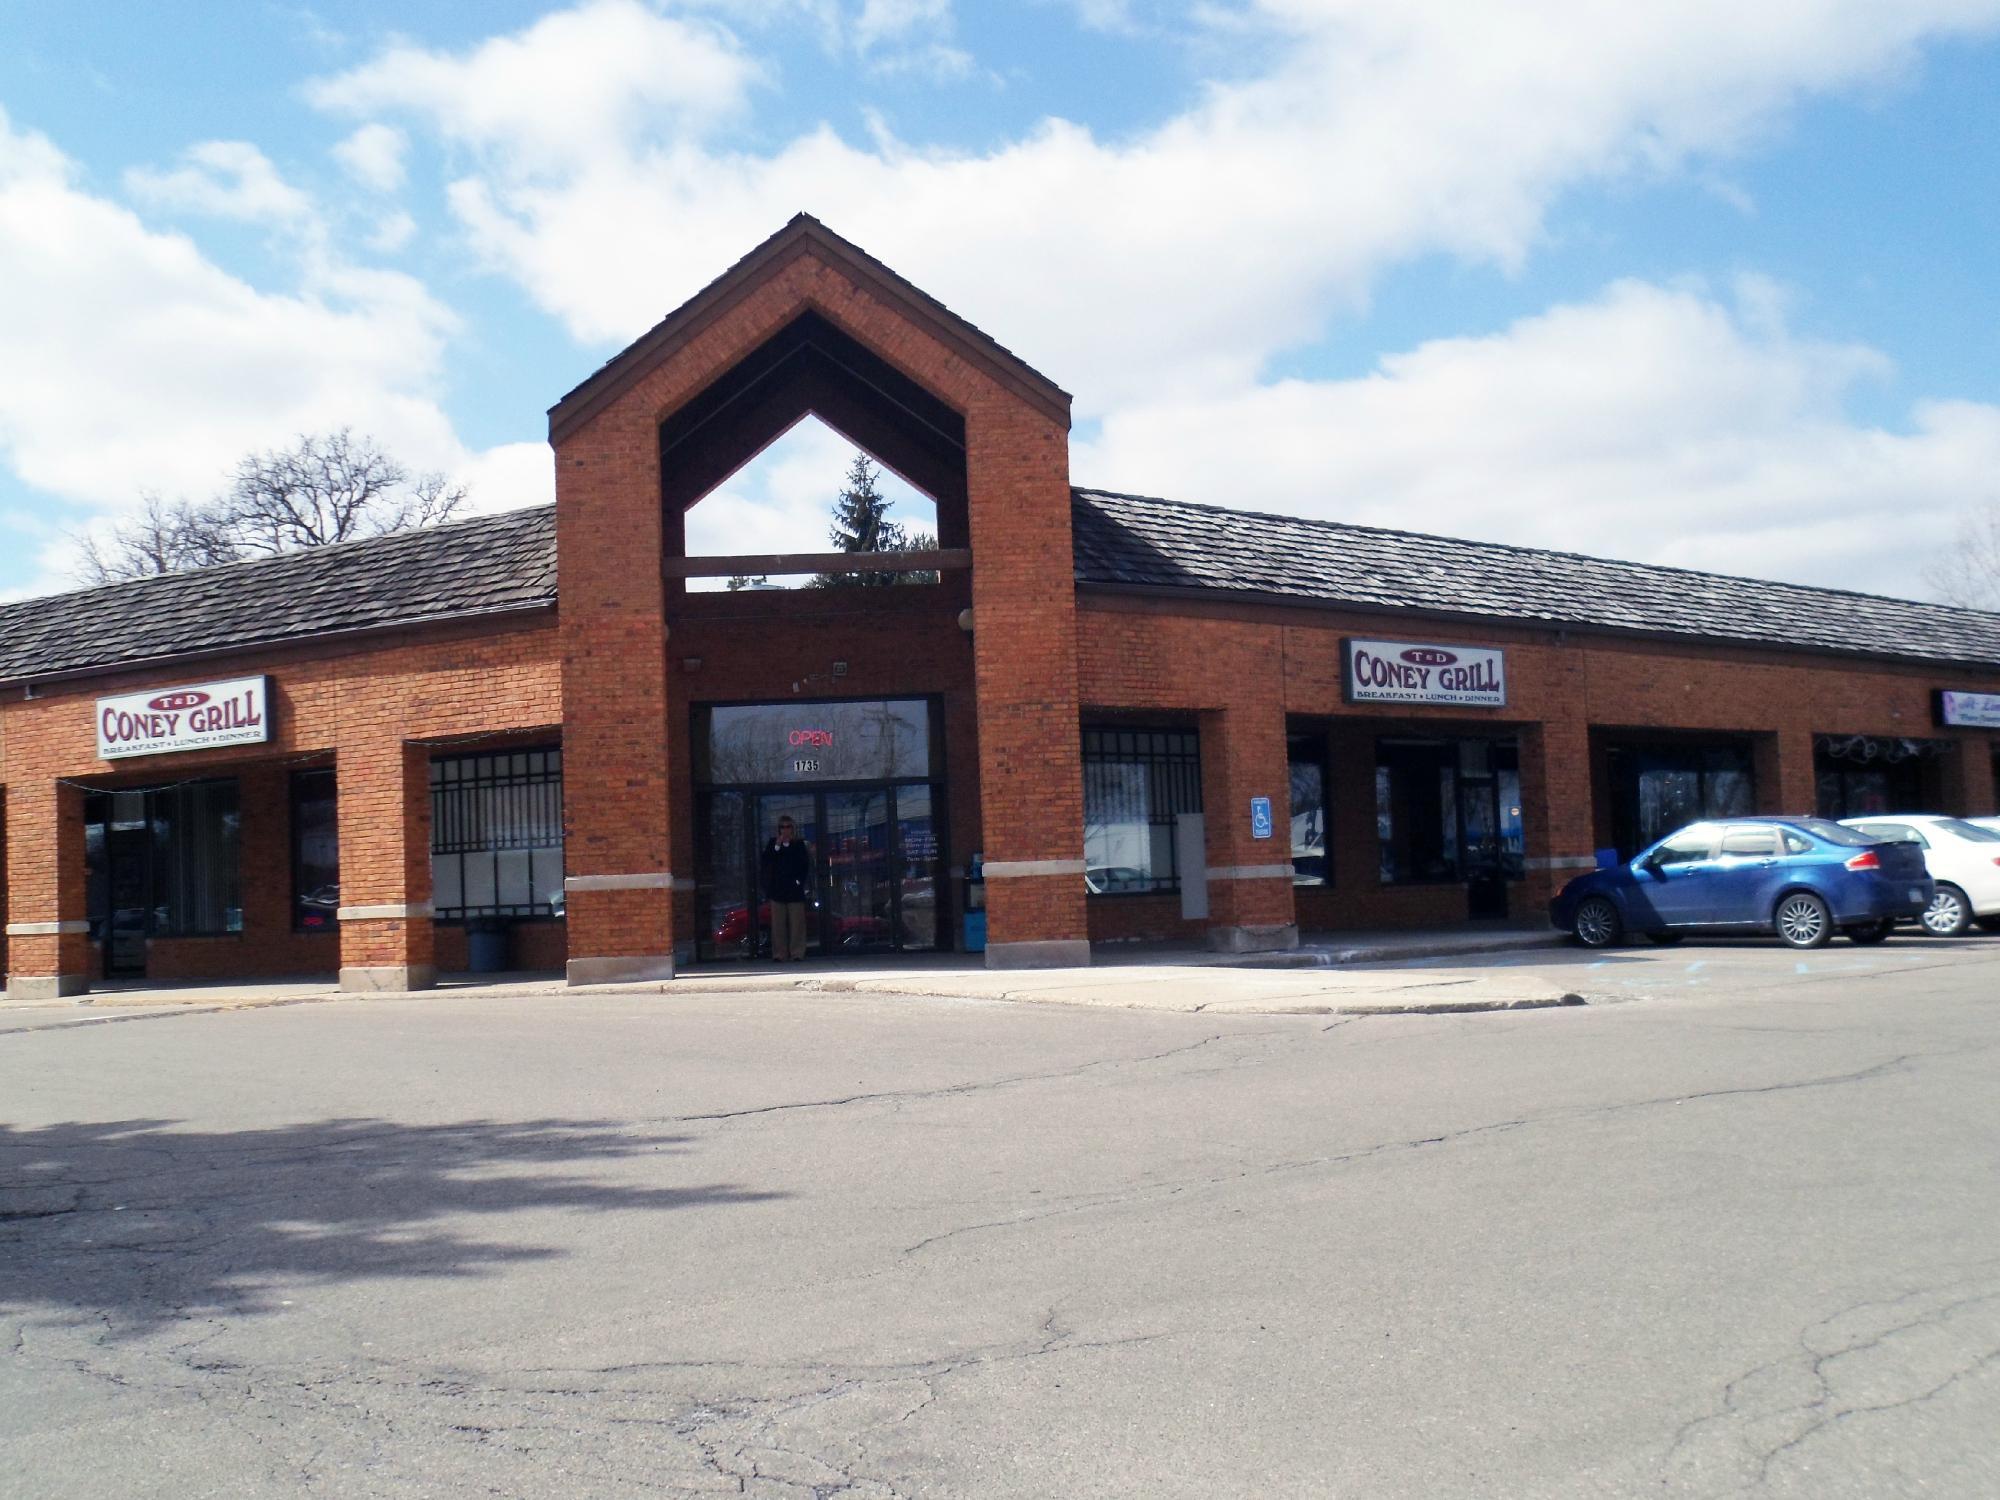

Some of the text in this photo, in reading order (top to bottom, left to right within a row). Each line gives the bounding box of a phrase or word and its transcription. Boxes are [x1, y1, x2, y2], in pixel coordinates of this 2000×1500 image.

[1355, 650, 1500, 693] CONEY GRILL
[1356, 691, 1500, 703] BREAKFAST LUNCH DINNER
[102, 690, 261, 743] CONEY GRILL
[103, 731, 261, 755] BREAKFAST LUNCH DINNER
[789, 730, 833, 746] OPEN
[796, 760, 819, 771] 1735
